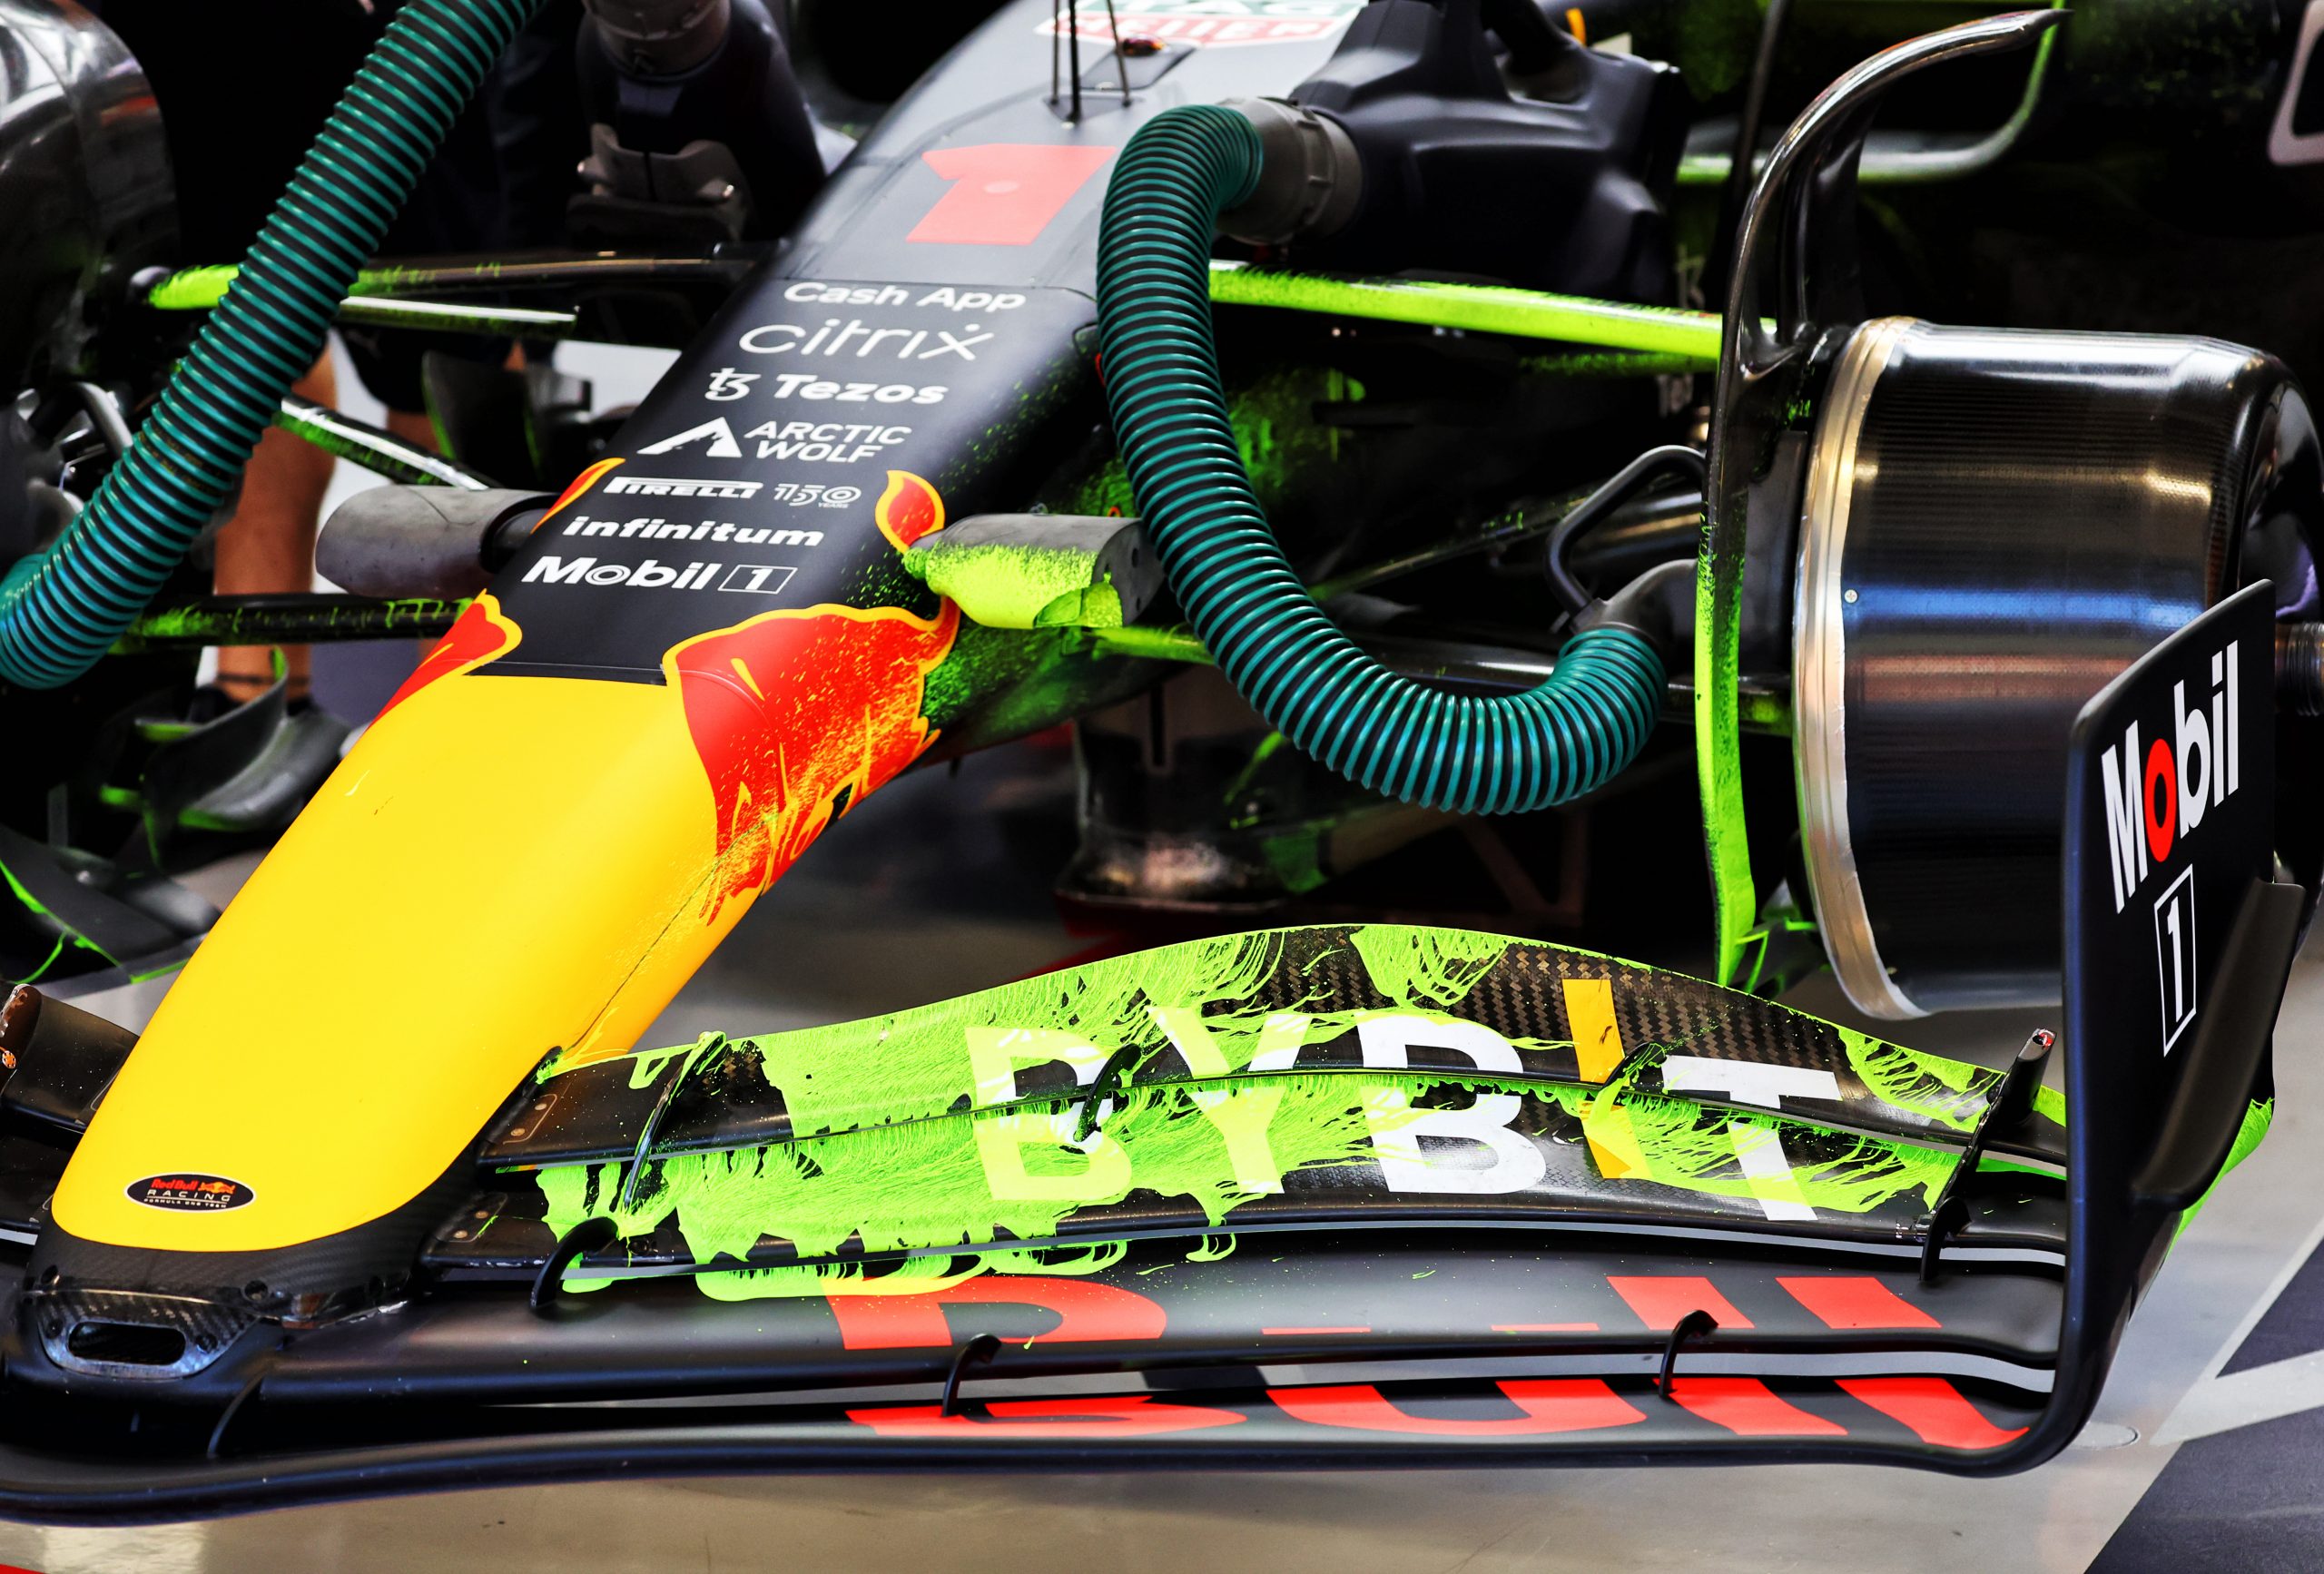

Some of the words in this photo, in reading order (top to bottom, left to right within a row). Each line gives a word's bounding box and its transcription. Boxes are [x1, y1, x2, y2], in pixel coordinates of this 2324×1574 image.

[905, 143, 1117, 246] 1
[783, 281, 909, 305] Cash
[915, 287, 1027, 312] App
[739, 319, 995, 361] citrix
[774, 373, 949, 404] Tezos
[743, 421, 912, 444] ARCTIC
[755, 440, 882, 463] WOLF
[603, 477, 763, 499] PIRELLI
[562, 516, 824, 546] infinitum
[521, 556, 723, 590] Mobil
[741, 567, 774, 591] 1
[2101, 639, 2240, 915] Mobil
[965, 979, 1841, 1222] BYBIT
[146, 1189, 231, 1202] RACING
[151, 1178, 174, 1189] Red
[173, 1179, 200, 1191] Bull
